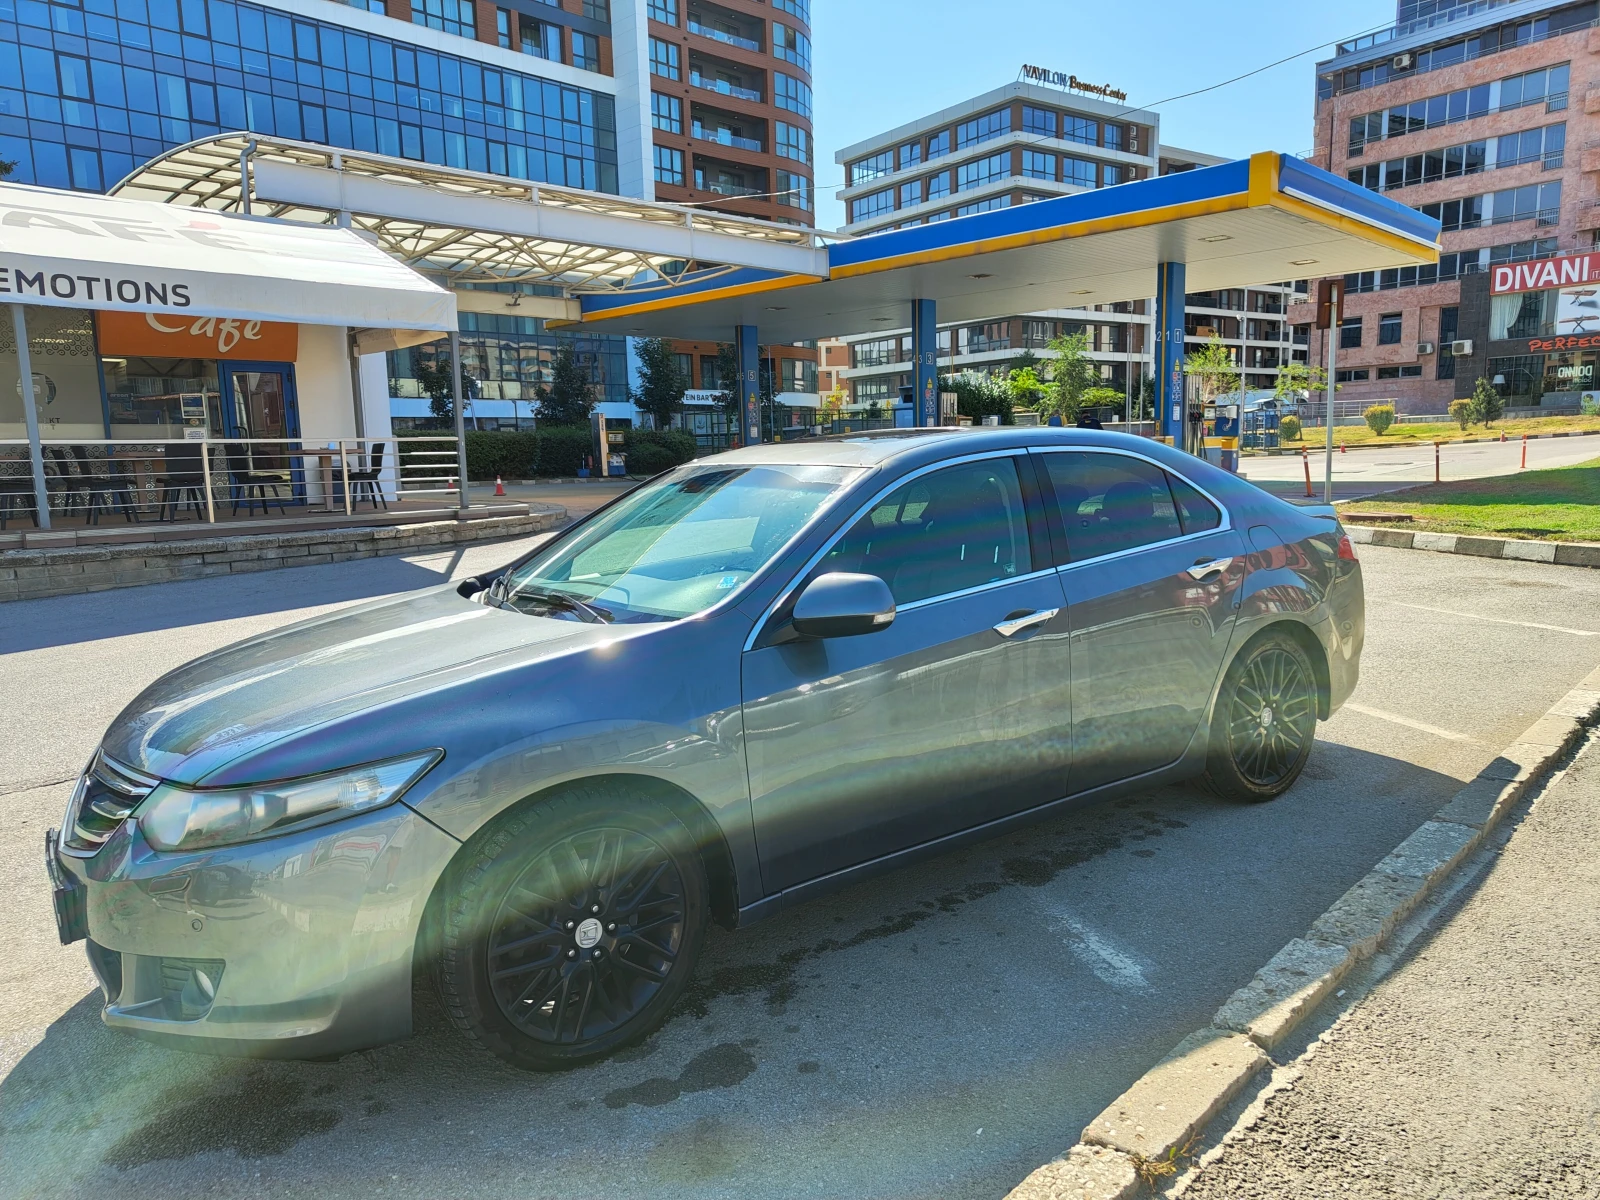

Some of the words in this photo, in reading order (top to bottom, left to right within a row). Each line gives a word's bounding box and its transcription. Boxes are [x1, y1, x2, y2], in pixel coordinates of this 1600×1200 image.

[1023, 64, 1067, 87] VAVILON
[1070, 75, 1103, 94] Business
[1103, 83, 1127, 100] Center
[1495, 256, 1589, 292] DIVANI
[696, 394, 710, 402] BAR
